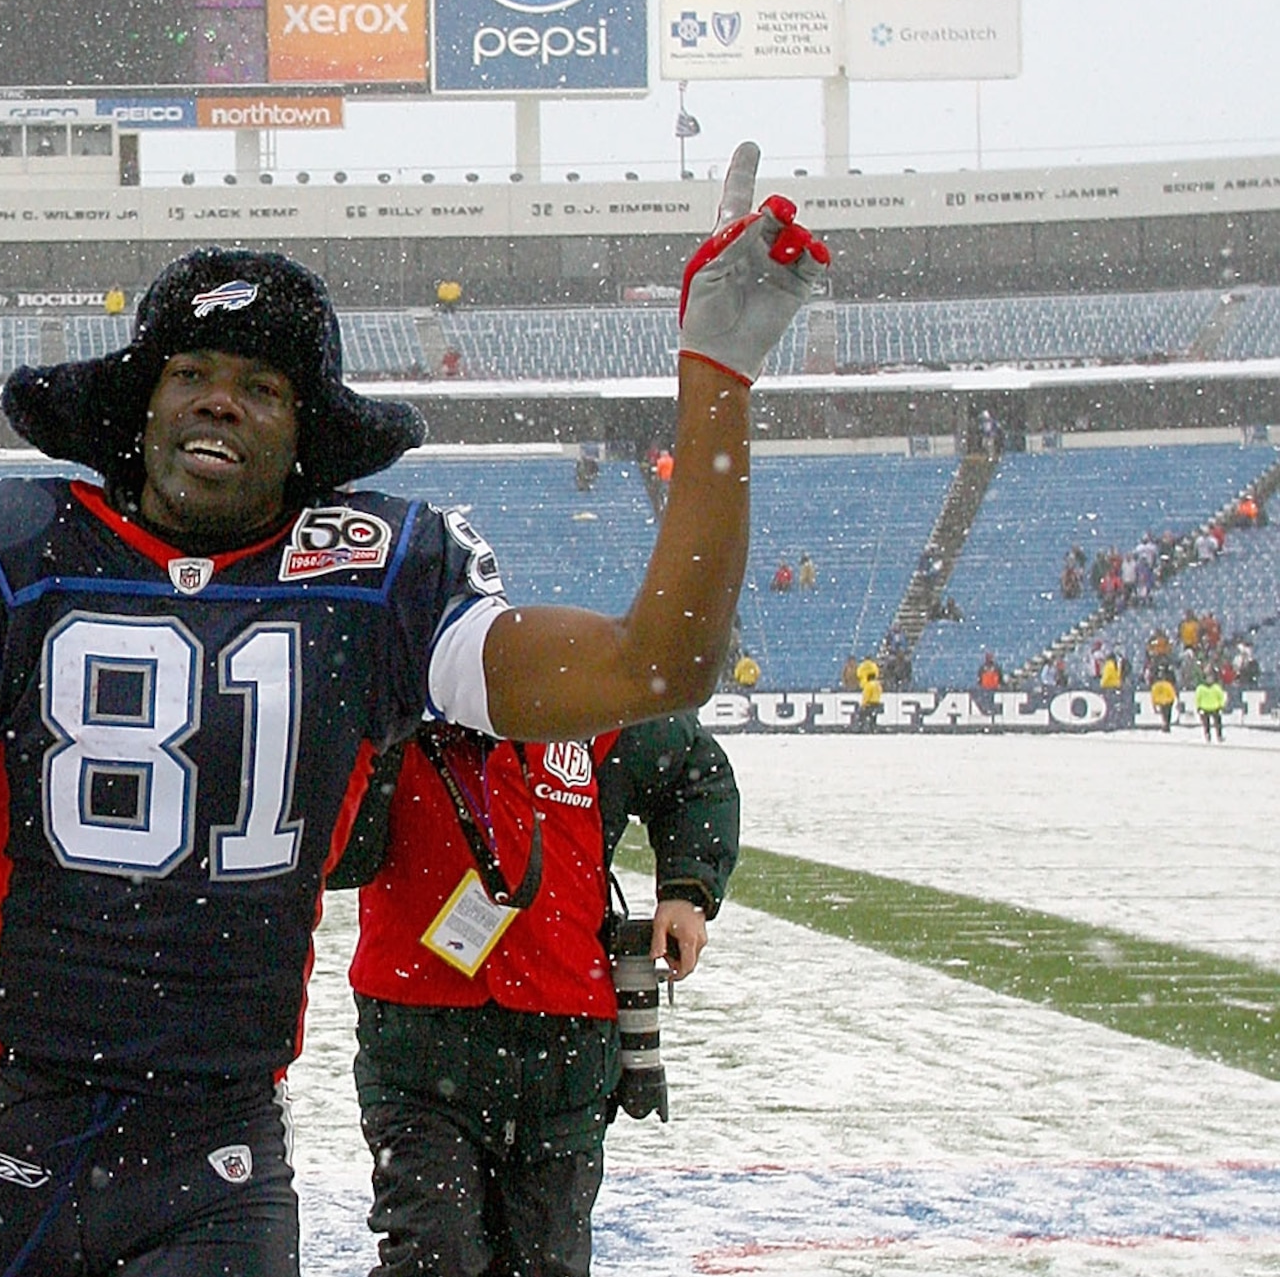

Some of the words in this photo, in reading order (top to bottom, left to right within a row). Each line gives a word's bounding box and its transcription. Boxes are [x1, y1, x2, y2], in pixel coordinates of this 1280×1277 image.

[283, 3, 408, 34] xerox
[757, 11, 778, 21] THE
[780, 11, 828, 21] OFFICIAL
[756, 23, 798, 32] HEALTH
[900, 26, 997, 42] Greatbatch
[473, 20, 608, 65] pepsi
[773, 34, 788, 43] OF
[754, 45, 802, 55] BUFFALO
[111, 106, 183, 122] GEICO
[210, 103, 331, 124] northtown
[17, 292, 106, 307] ROCKPIL
[696, 690, 1108, 726] BUFFALO
[42, 610, 303, 882] 81
[550, 741, 587, 778] NFL
[534, 783, 593, 809] Canon
